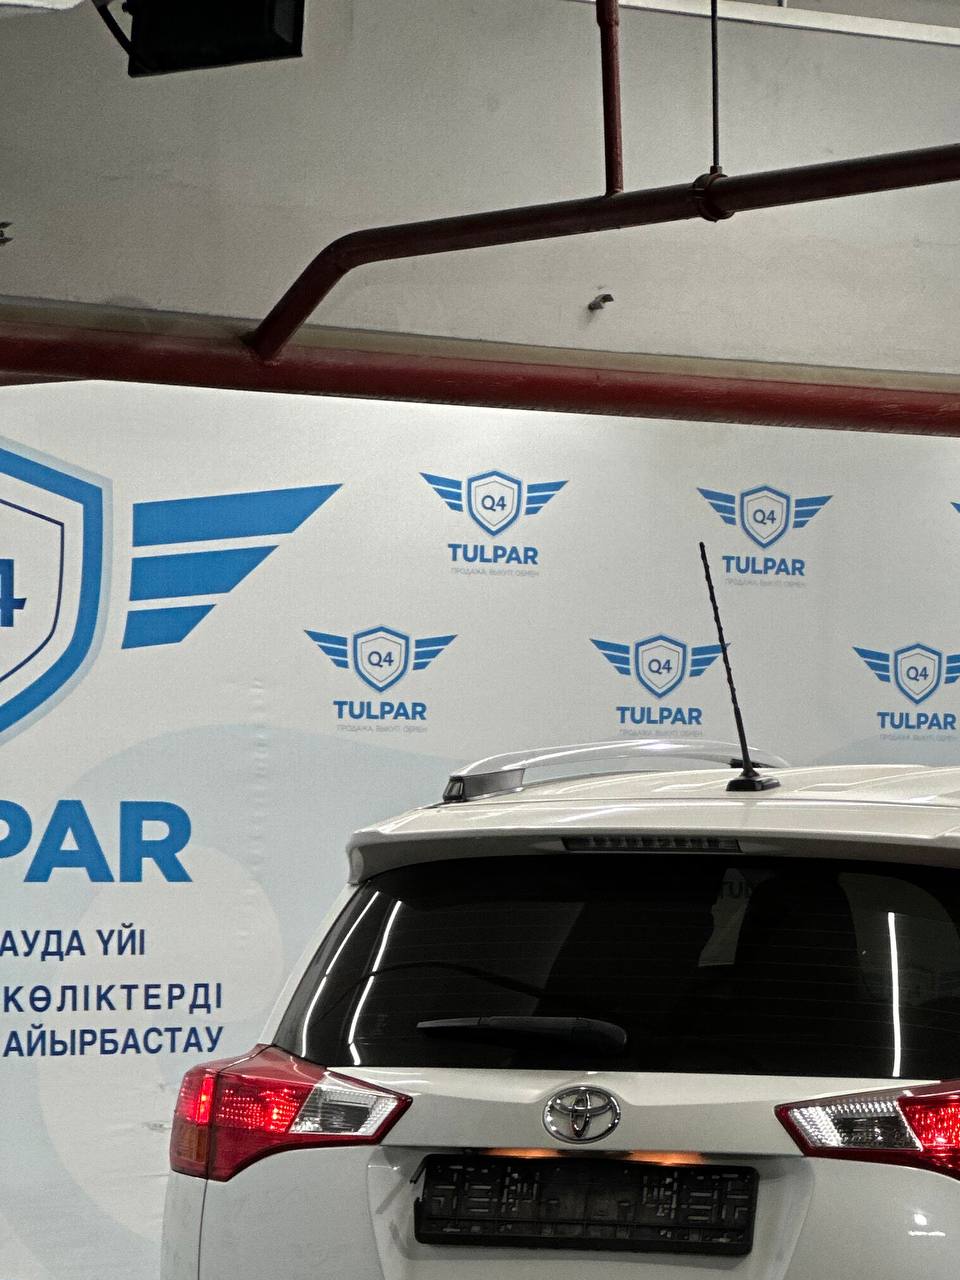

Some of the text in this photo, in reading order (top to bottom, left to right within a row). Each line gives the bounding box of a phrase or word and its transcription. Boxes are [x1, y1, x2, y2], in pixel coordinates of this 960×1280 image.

[481, 495, 507, 511] Q4
[753, 509, 777, 525] Q4
[448, 543, 538, 565] TULPAR
[722, 556, 805, 576] TULPAR
[367, 651, 394, 668] Q4
[648, 659, 672, 675] Q4
[906, 666, 929, 682] Q4
[333, 700, 427, 720] TULPAR
[616, 706, 702, 725] TULPAR
[877, 711, 957, 730] TULPAR
[3, 983, 222, 1015] КӨЛІКТЕРДІ
[3, 1023, 224, 1057] АЙЫРБАСТАУ
